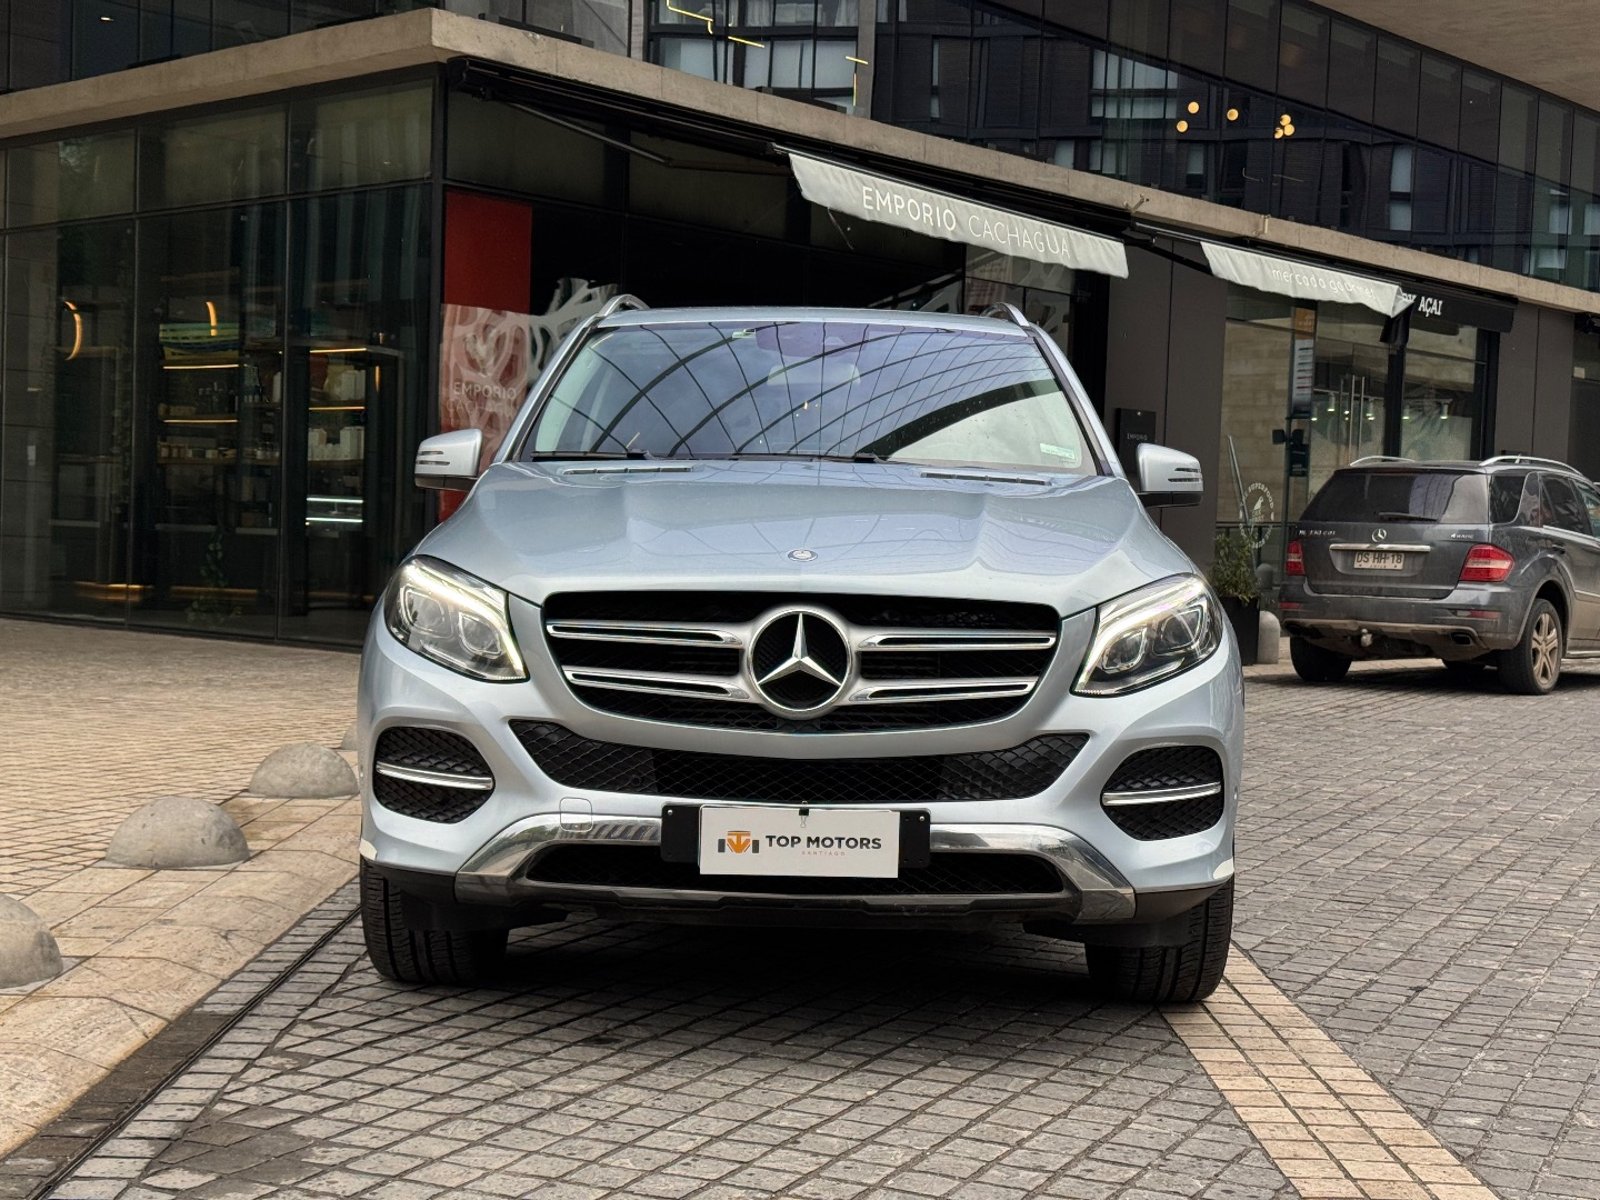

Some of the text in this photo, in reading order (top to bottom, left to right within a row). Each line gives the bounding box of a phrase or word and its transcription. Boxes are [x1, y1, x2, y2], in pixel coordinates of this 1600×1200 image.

[862, 186, 1071, 259] EMPORIO CACHAGUA
[1272, 269, 1326, 289] mercado
[454, 382, 517, 400] EMPORIO
[765, 835, 882, 849] TOP MOTORS
